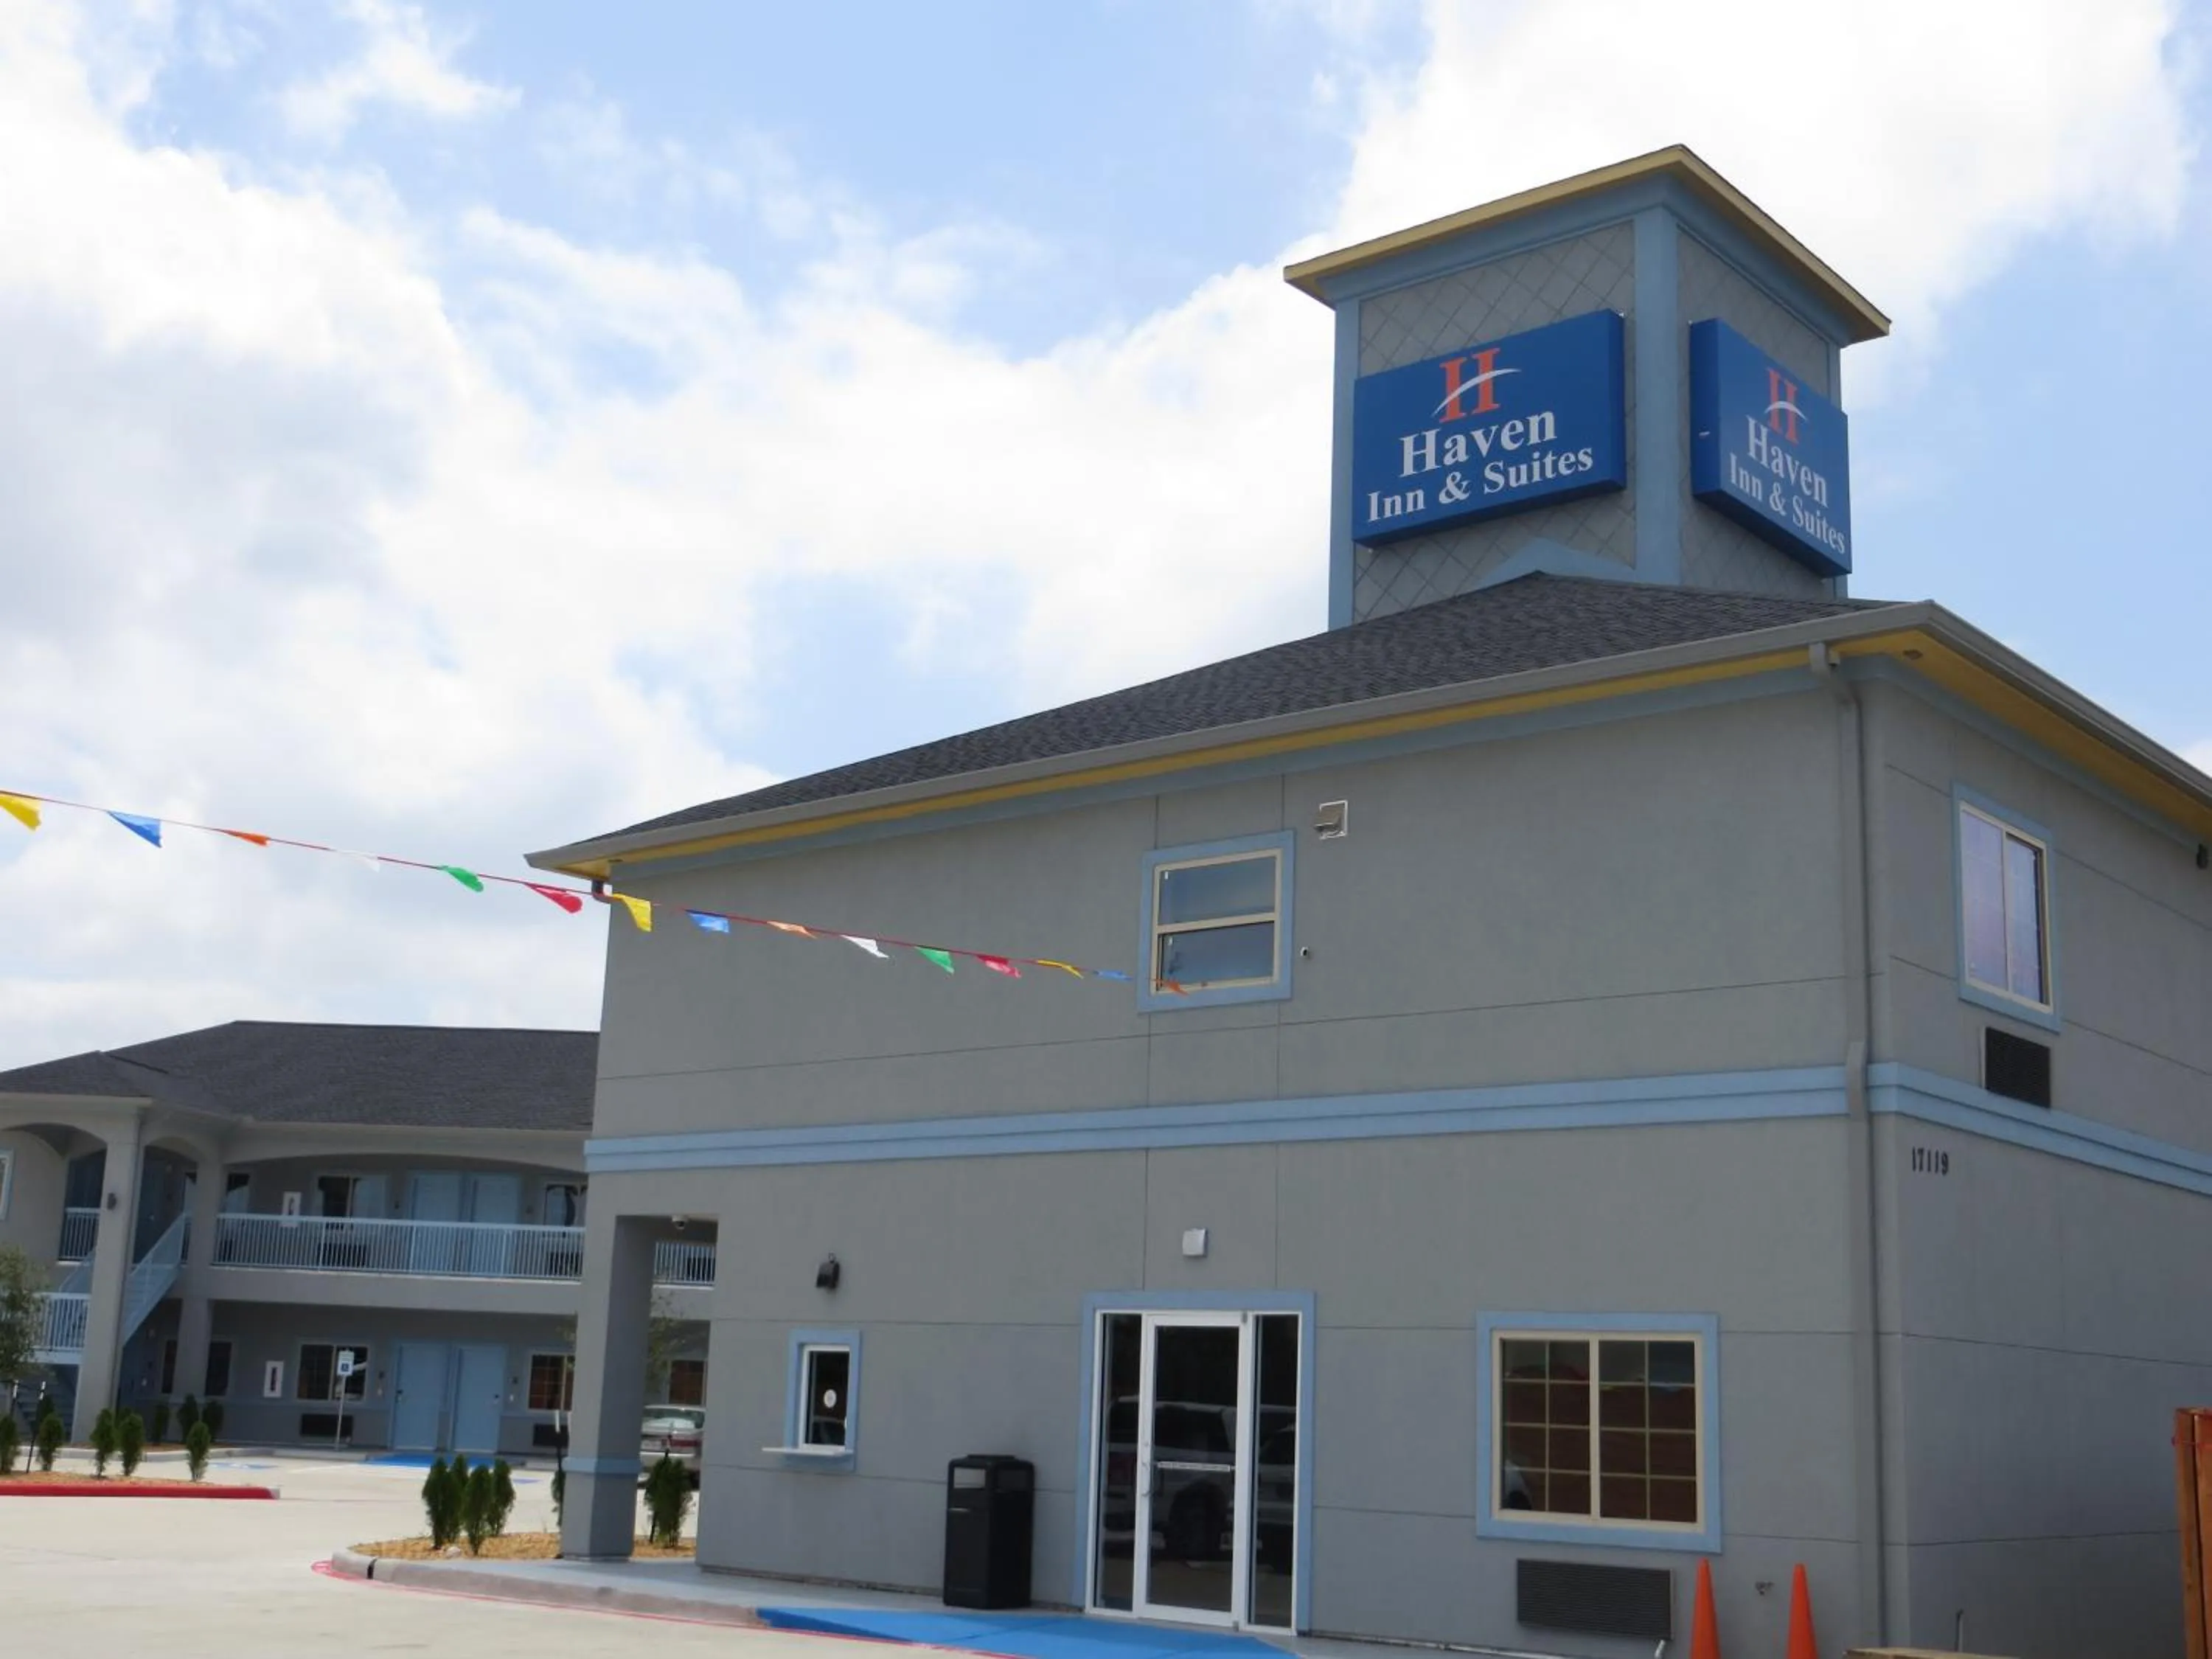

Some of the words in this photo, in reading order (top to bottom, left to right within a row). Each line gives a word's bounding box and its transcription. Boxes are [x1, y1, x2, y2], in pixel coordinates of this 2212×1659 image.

[1399, 410, 1558, 478] Haven
[1745, 414, 1829, 509] Haven
[1367, 487, 1426, 523] Inn
[1439, 470, 1472, 505] &
[1483, 447, 1594, 495] Suites
[1729, 452, 1763, 502] Inn
[1769, 481, 1787, 516] &
[1792, 495, 1846, 554] Suites
[1912, 1146, 1949, 1176] 17119
